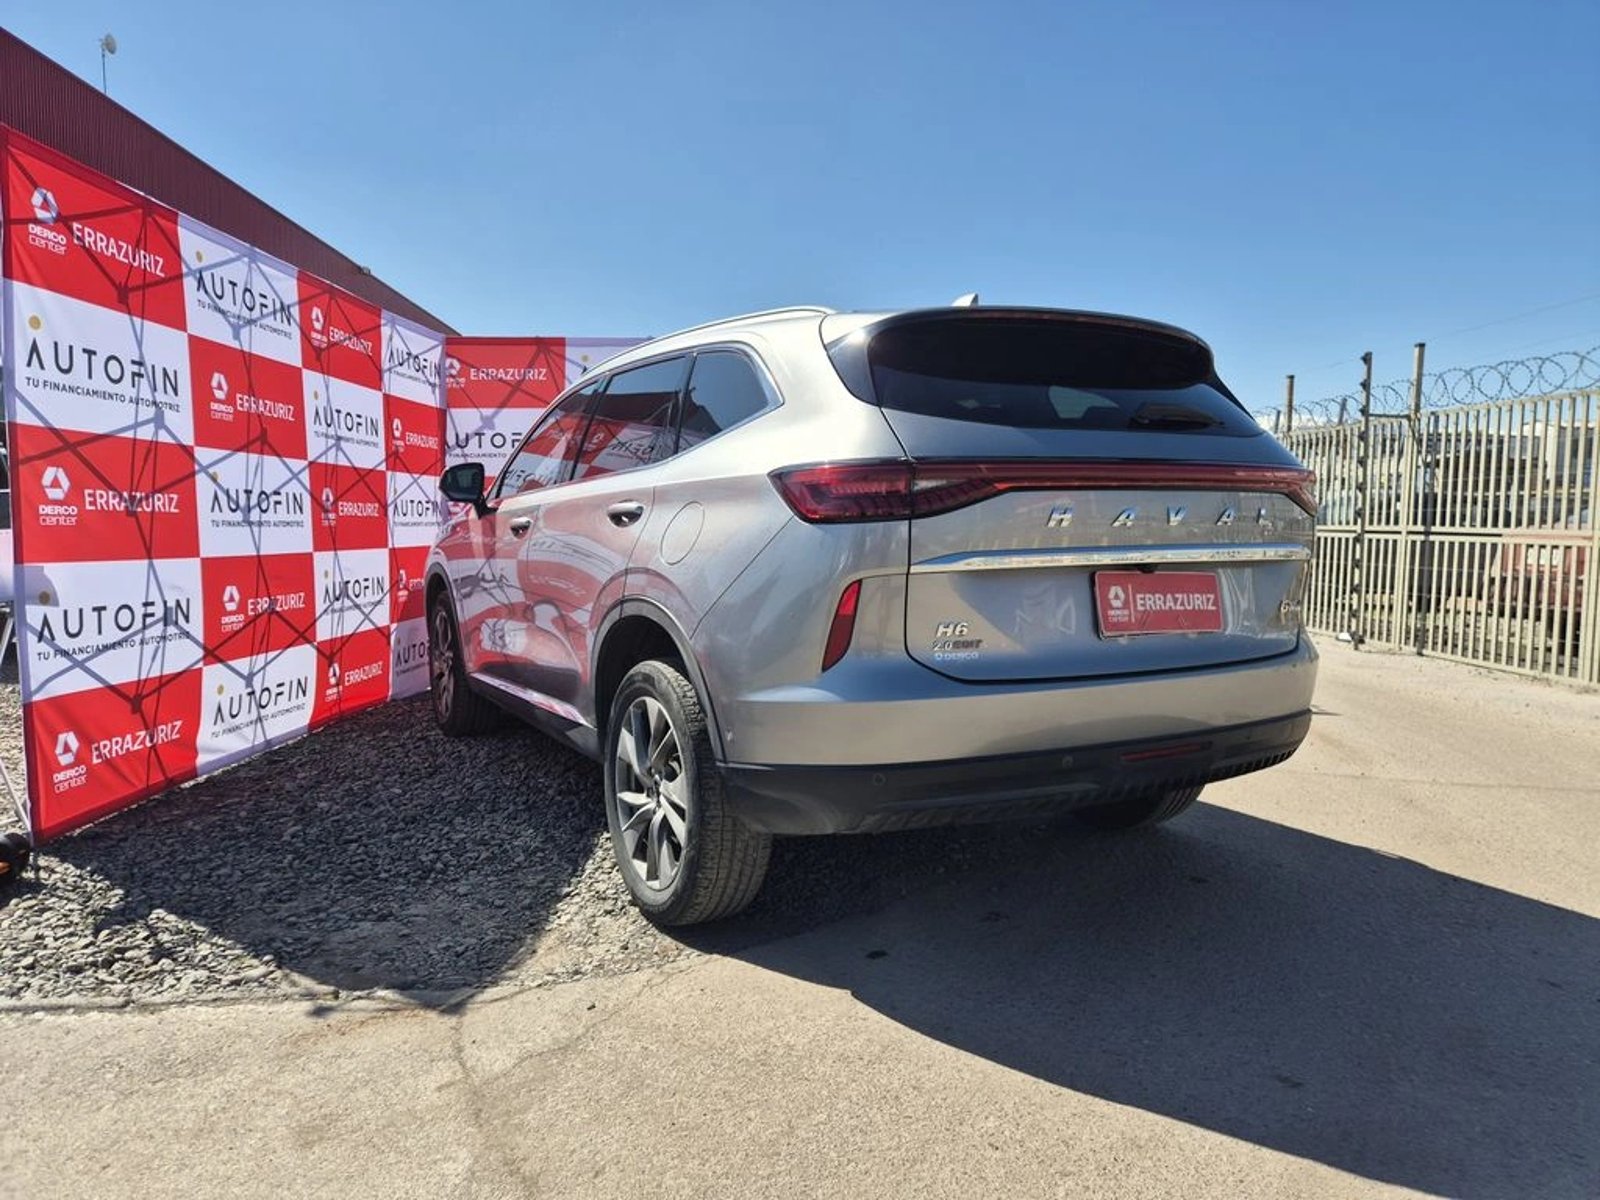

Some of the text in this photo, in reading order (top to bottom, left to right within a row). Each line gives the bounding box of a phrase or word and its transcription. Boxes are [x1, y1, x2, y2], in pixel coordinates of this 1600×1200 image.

[28, 223, 67, 246] DERCO
[29, 234, 67, 256] center
[73, 221, 165, 277] ERRAZURIZ
[196, 269, 293, 327] AUTOFIN
[26, 337, 180, 397] AUTOFIN
[389, 347, 441, 381] AUTOFIN
[470, 368, 547, 380] ERRAZURIZ
[26, 376, 180, 413] TU FINANCIAMIENTO AUTOMOTRIZ
[236, 393, 295, 422] ERRAZURIZ
[313, 405, 379, 438] AUTOFIN
[39, 505, 78, 516] DERCO
[84, 489, 180, 513] ERRAZURIZ
[211, 487, 304, 515] AUTOFIN
[338, 501, 379, 517] ERRAZURIZ
[40, 516, 78, 526] center
[322, 576, 384, 604] AUTOFIN
[1136, 593, 1217, 611] ERRAZURIZ
[248, 592, 306, 616] ERRAZURIZ
[37, 598, 191, 644] AUTOFIN
[935, 622, 969, 638] H6
[37, 651, 50, 661] TU
[54, 637, 136, 659] FINANCIAMIENTO
[395, 641, 430, 668] AUTO
[344, 660, 384, 687] ERRAZURIZ
[213, 676, 309, 727] AUTOFIN
[91, 719, 183, 765] ERRAZURIZ
[53, 765, 87, 783] DERCO
[54, 774, 88, 794] center
